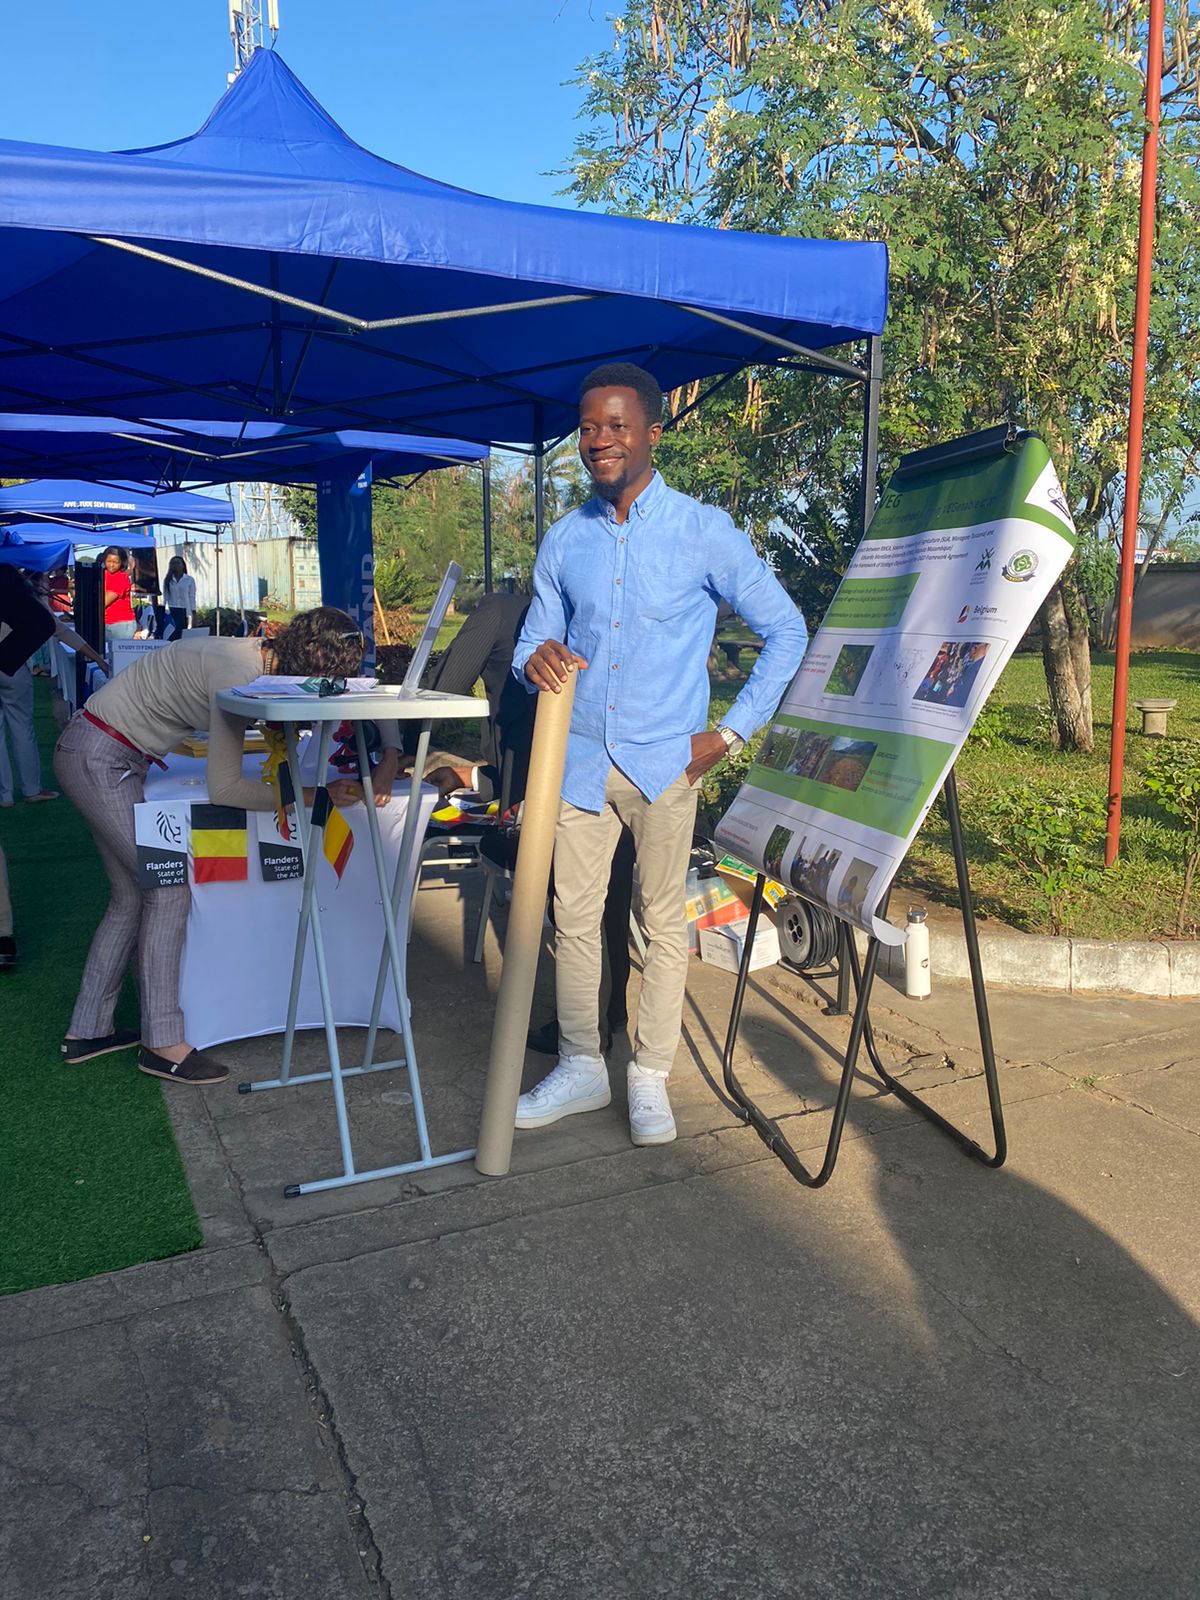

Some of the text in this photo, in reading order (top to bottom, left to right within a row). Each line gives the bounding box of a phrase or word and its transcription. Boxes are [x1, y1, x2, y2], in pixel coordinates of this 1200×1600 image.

[973, 605, 997, 615] Belgium
[146, 860, 184, 871] Flanders
[264, 856, 299, 866] Flanders
[157, 870, 173, 878] State
[277, 872, 288, 880] the
